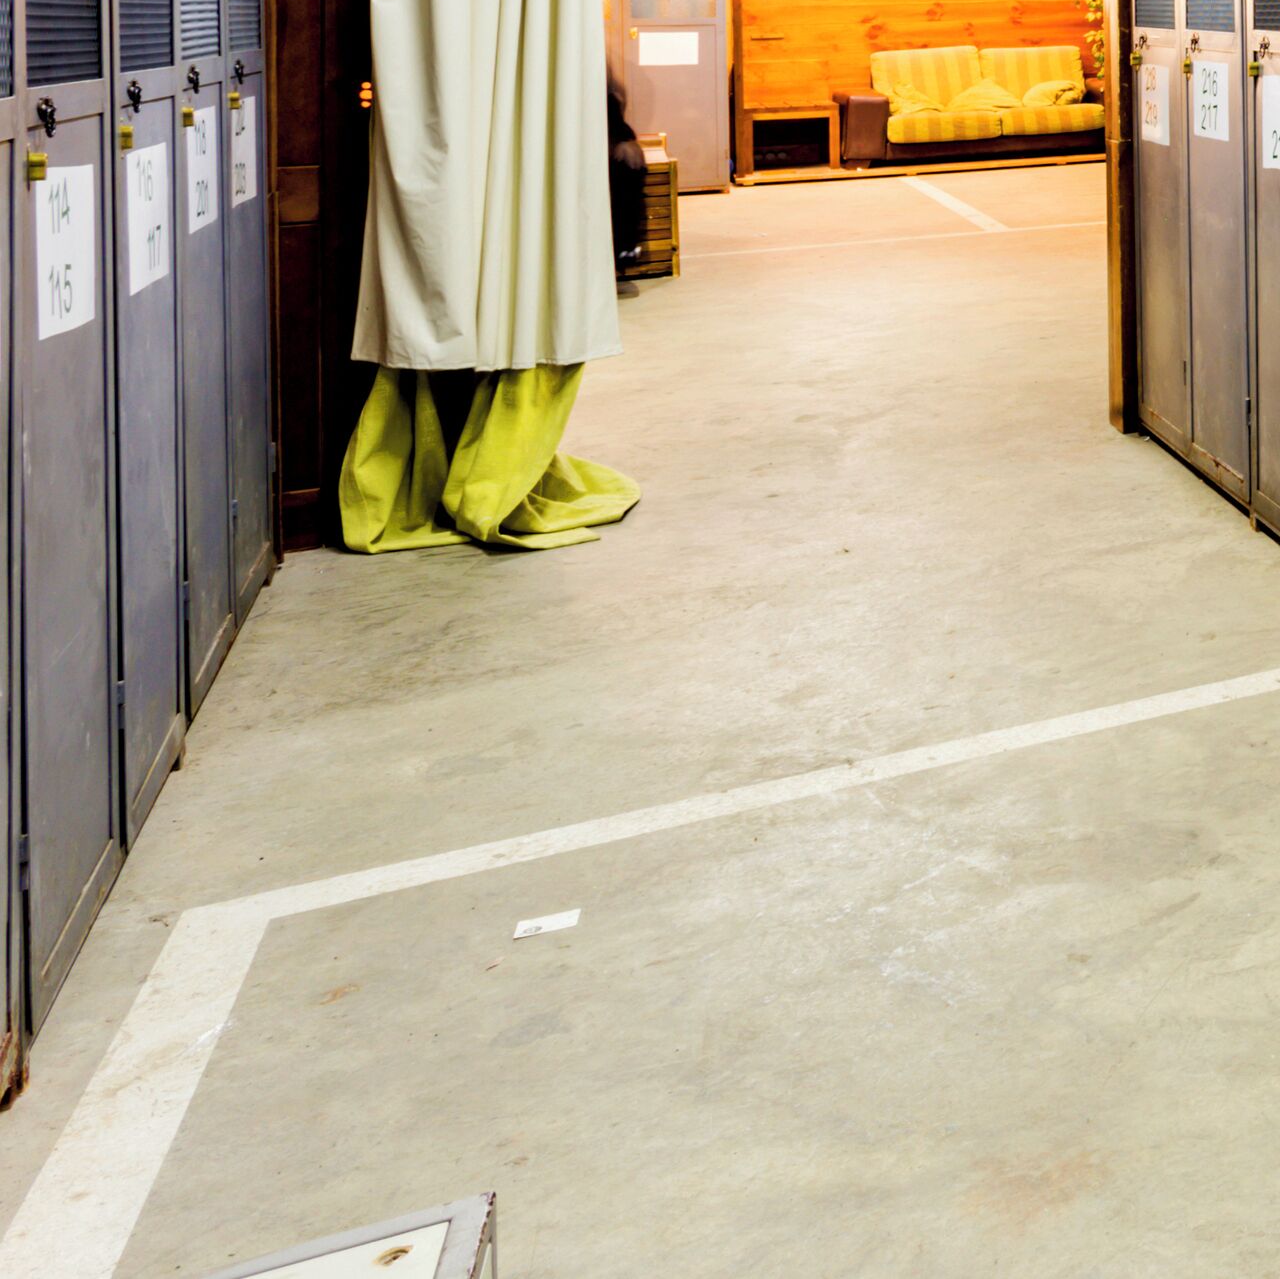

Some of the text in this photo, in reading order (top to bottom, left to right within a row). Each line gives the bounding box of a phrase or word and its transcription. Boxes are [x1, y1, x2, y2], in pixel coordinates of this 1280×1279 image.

[1201, 68, 1218, 97] 216
[194, 119, 206, 157] 118
[1201, 104, 1218, 131] 217
[136, 157, 153, 202] 116
[196, 179, 208, 217] 201
[48, 177, 71, 235] 114
[146, 224, 162, 272] 117
[48, 263, 72, 320] 115
